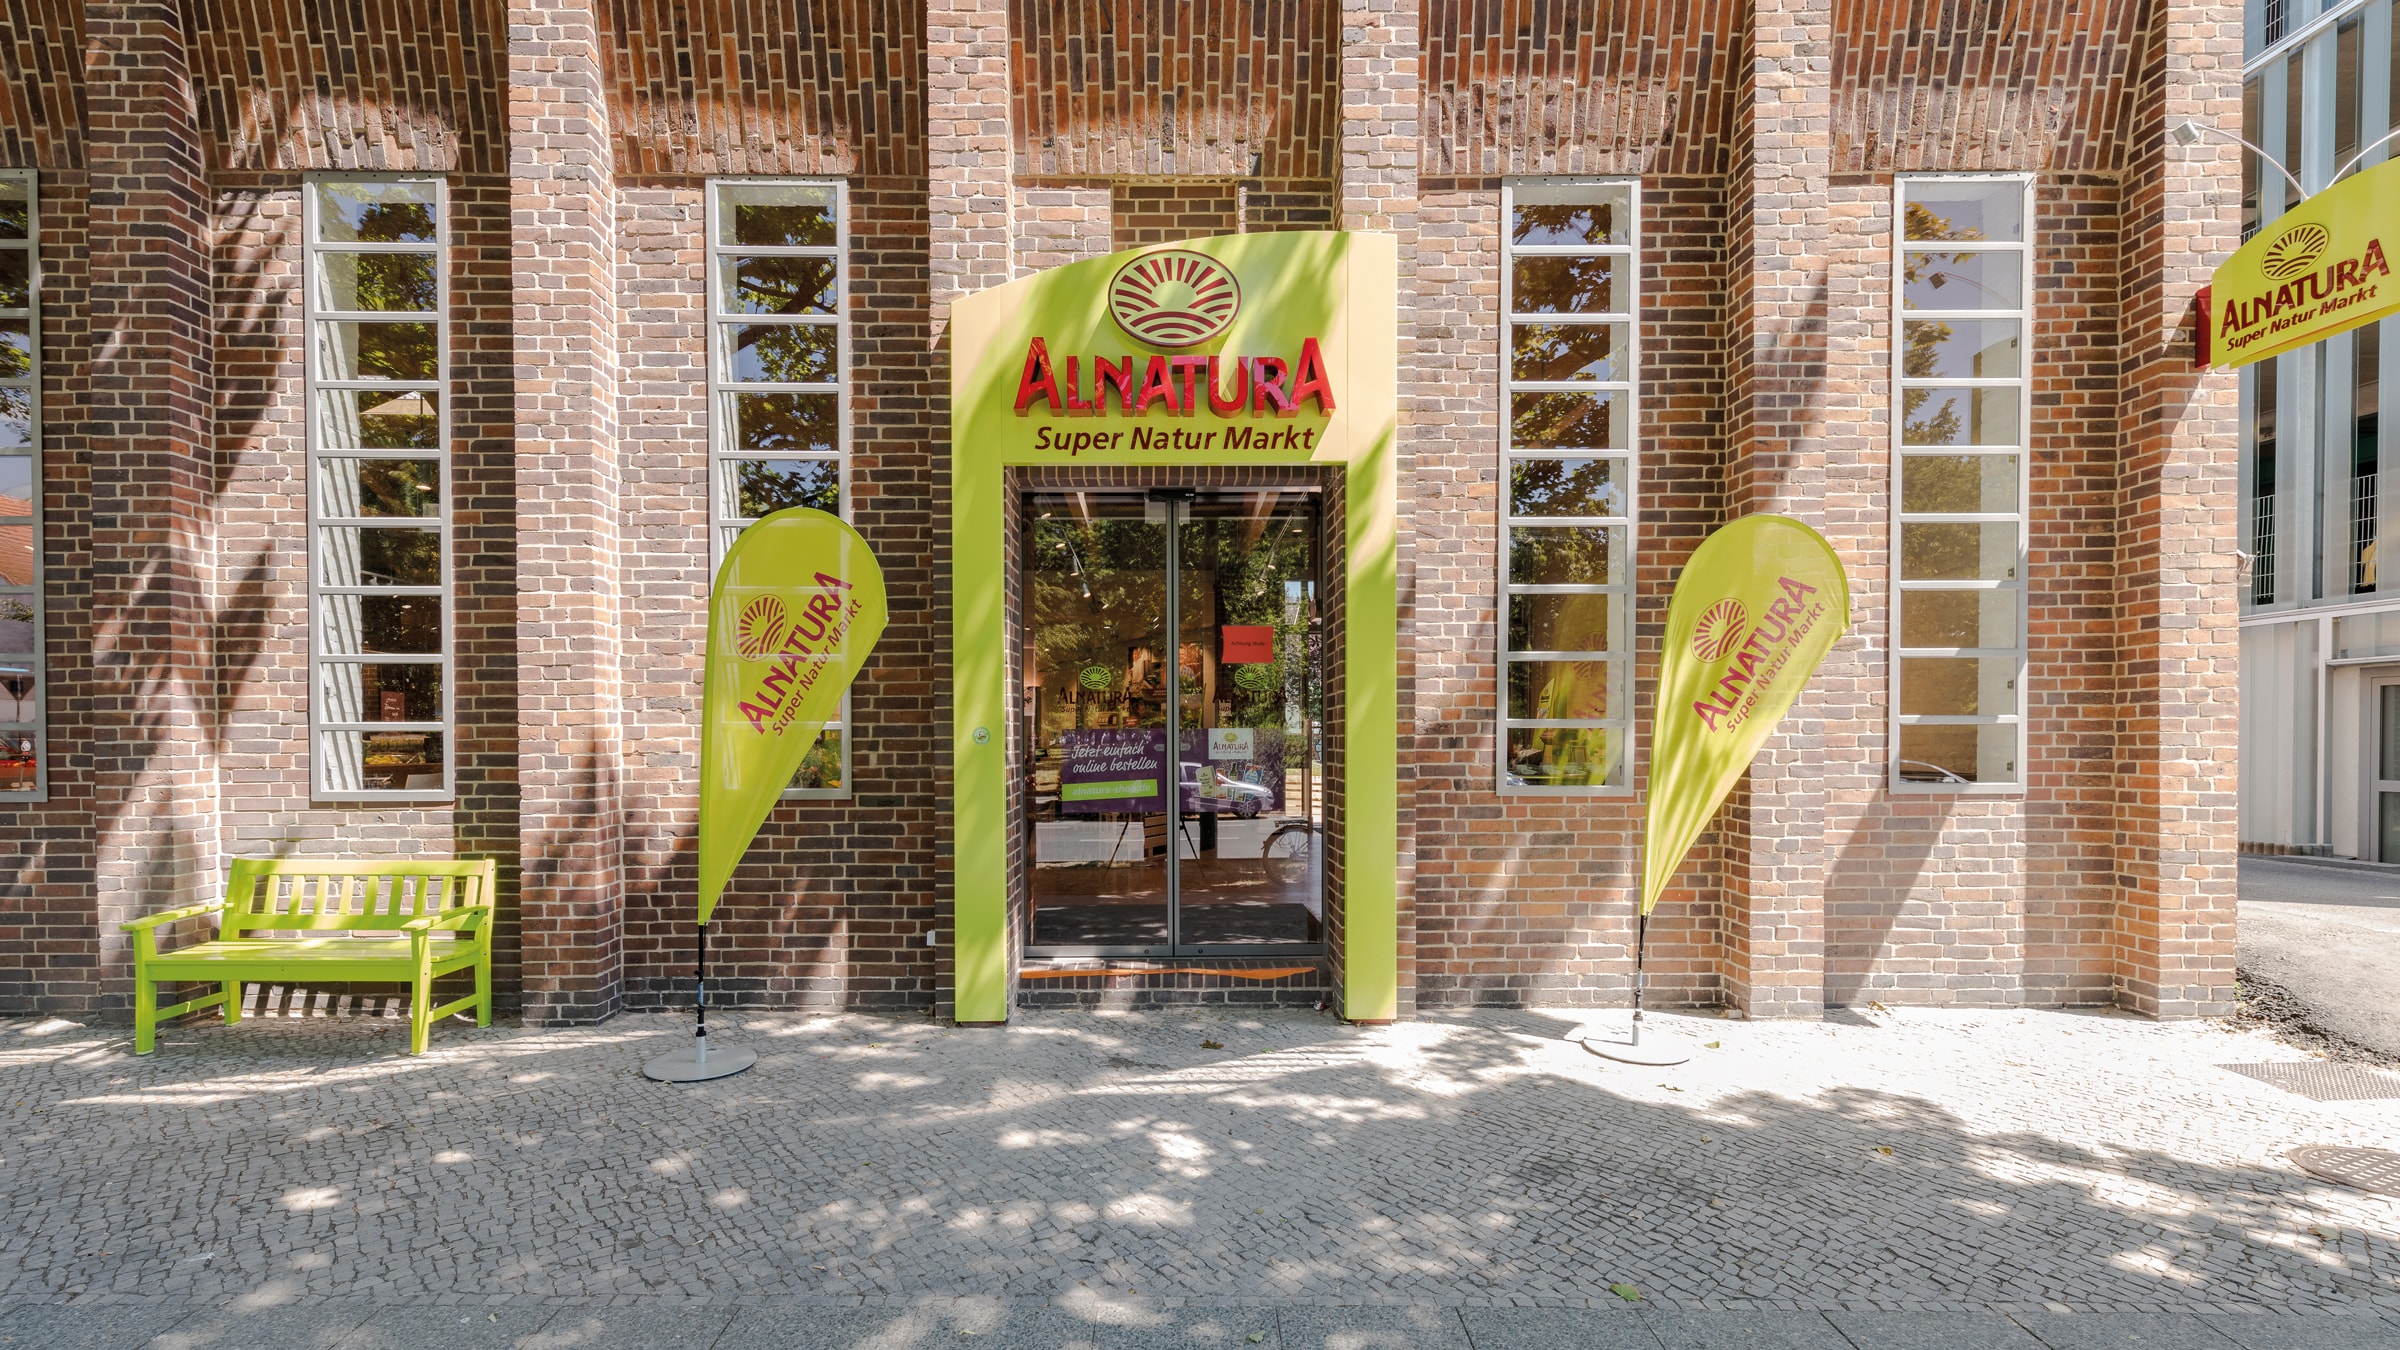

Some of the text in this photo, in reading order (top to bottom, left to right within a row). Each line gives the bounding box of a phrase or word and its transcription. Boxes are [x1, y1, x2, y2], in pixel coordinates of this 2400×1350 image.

[2220, 239, 2390, 339] ALNATURA
[2227, 284, 2378, 351] Super Natur Markt
[1013, 336, 1336, 418] ALNATURA
[1034, 424, 1314, 456] Super Natur Markt
[738, 571, 854, 735] ALNATURA
[772, 598, 863, 736] Super Natur Markt
[1693, 576, 1818, 733] ALNATURA
[1726, 601, 1826, 734] Super Natur Markt
[1057, 686, 1132, 704] ALNATURA
[1212, 686, 1287, 703] ALTUA
[1071, 740, 1144, 759] Jetzt einfach
[1073, 757, 1158, 773] online bestellen
[1213, 741, 1249, 750] ALNATURA
